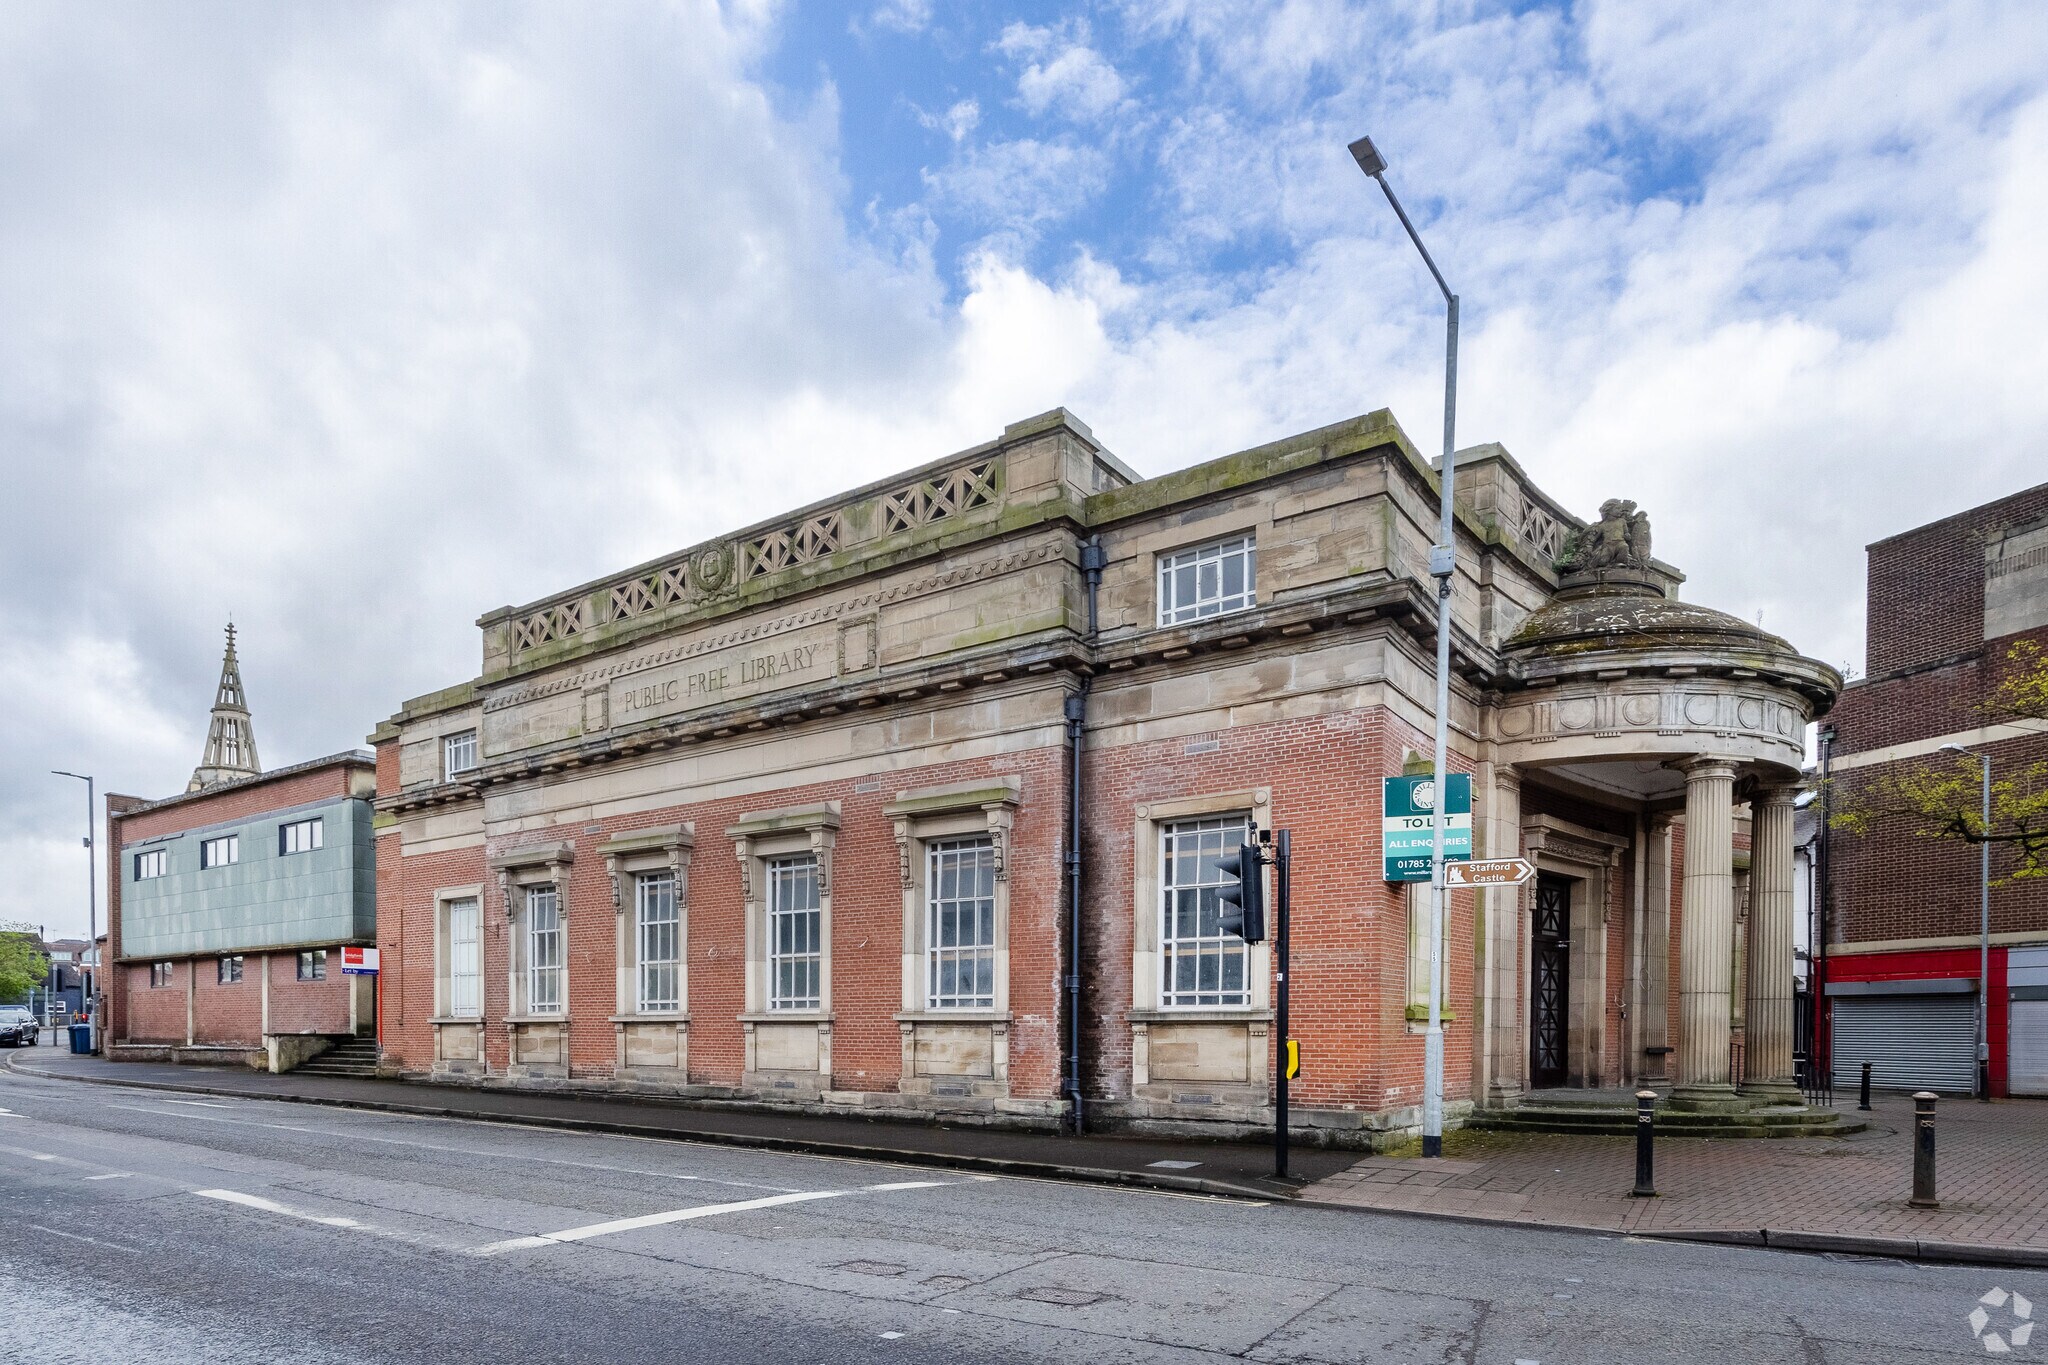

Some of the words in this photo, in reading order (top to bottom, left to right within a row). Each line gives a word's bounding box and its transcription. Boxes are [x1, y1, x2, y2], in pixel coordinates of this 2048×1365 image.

[624, 679, 679, 713] PUBLIC
[687, 666, 730, 698] FREE
[741, 643, 819, 684] LIBRARY
[1403, 818, 1423, 828] TO
[1426, 816, 1453, 827] LT
[1389, 840, 1409, 848] ALL
[1411, 837, 1468, 848] ENQIRIES
[1397, 859, 1425, 868] 01785
[1469, 862, 1511, 872] Stafford
[1473, 874, 1506, 883] Castle
